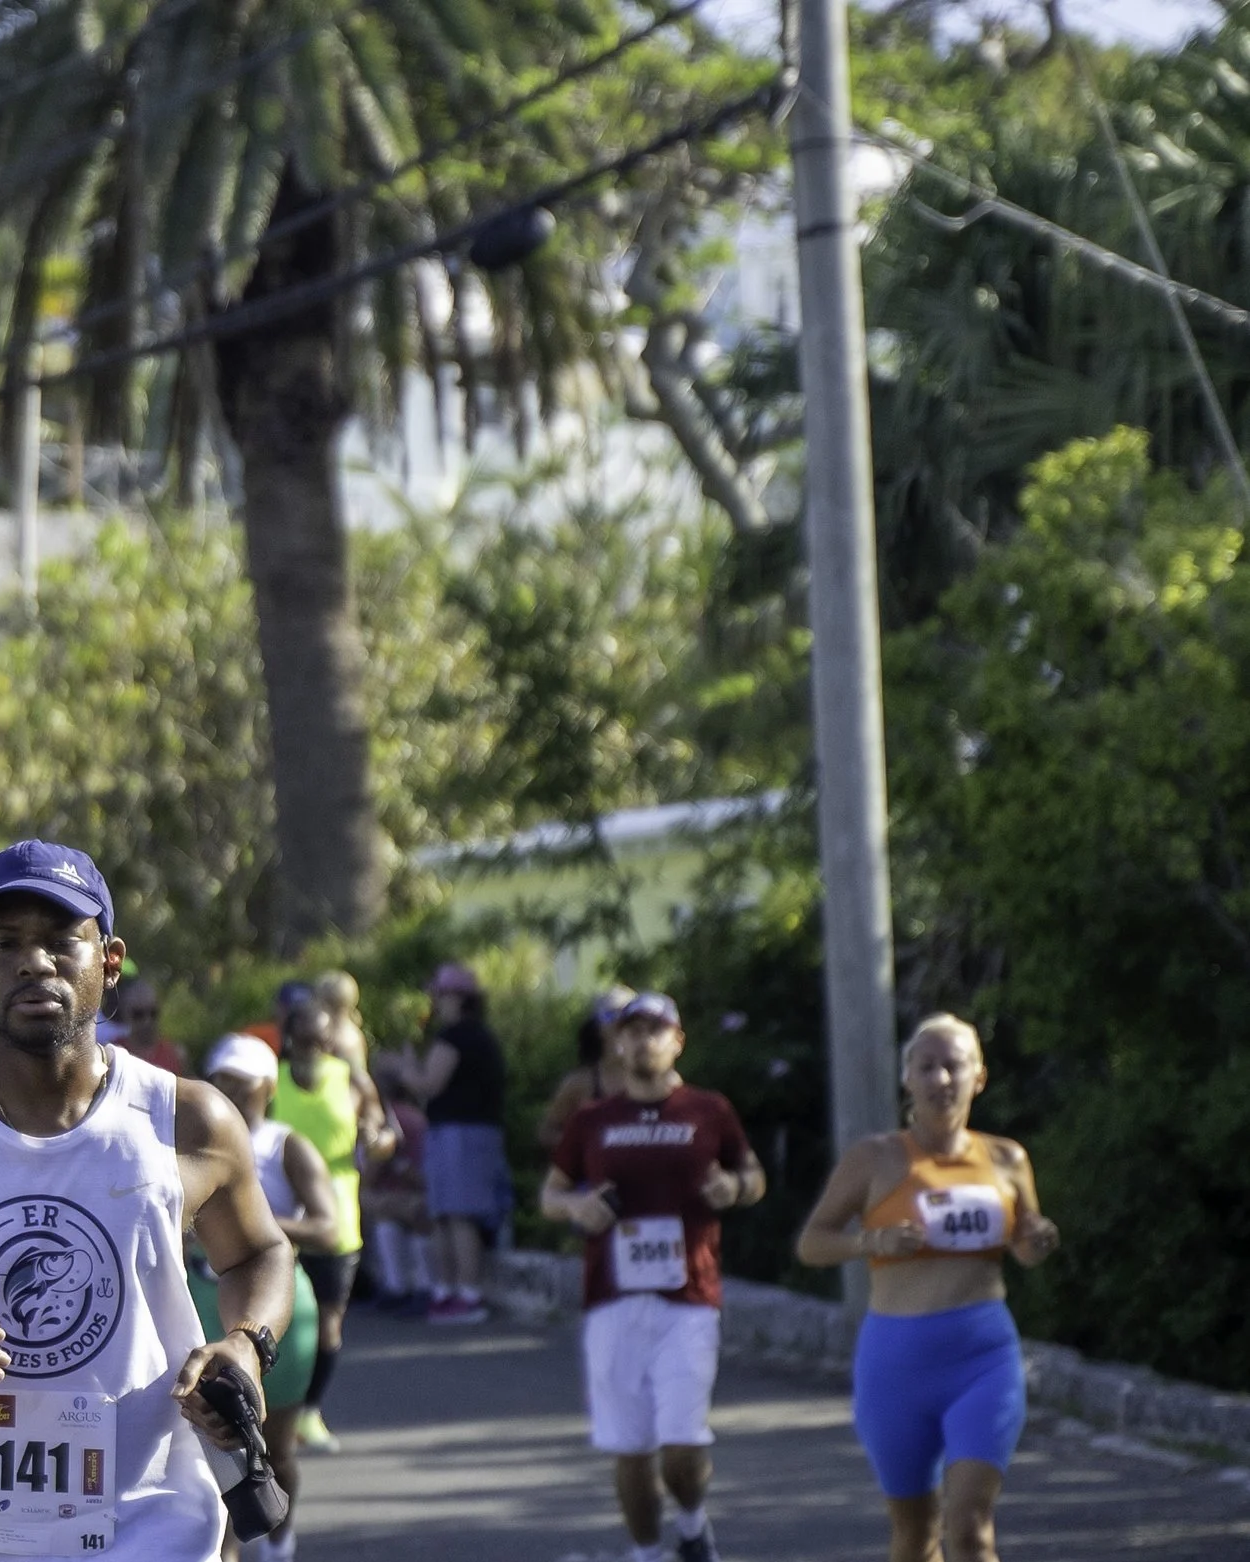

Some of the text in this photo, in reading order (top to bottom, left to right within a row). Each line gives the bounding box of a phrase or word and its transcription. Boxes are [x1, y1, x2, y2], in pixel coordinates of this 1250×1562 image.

[22, 1205, 59, 1228] ER
[943, 1209, 989, 1234] 440
[46, 1352, 59, 1366] &
[60, 1312, 108, 1362] FOODS
[58, 1411, 102, 1423] ARGUS
[80, 1534, 105, 1549] 141
